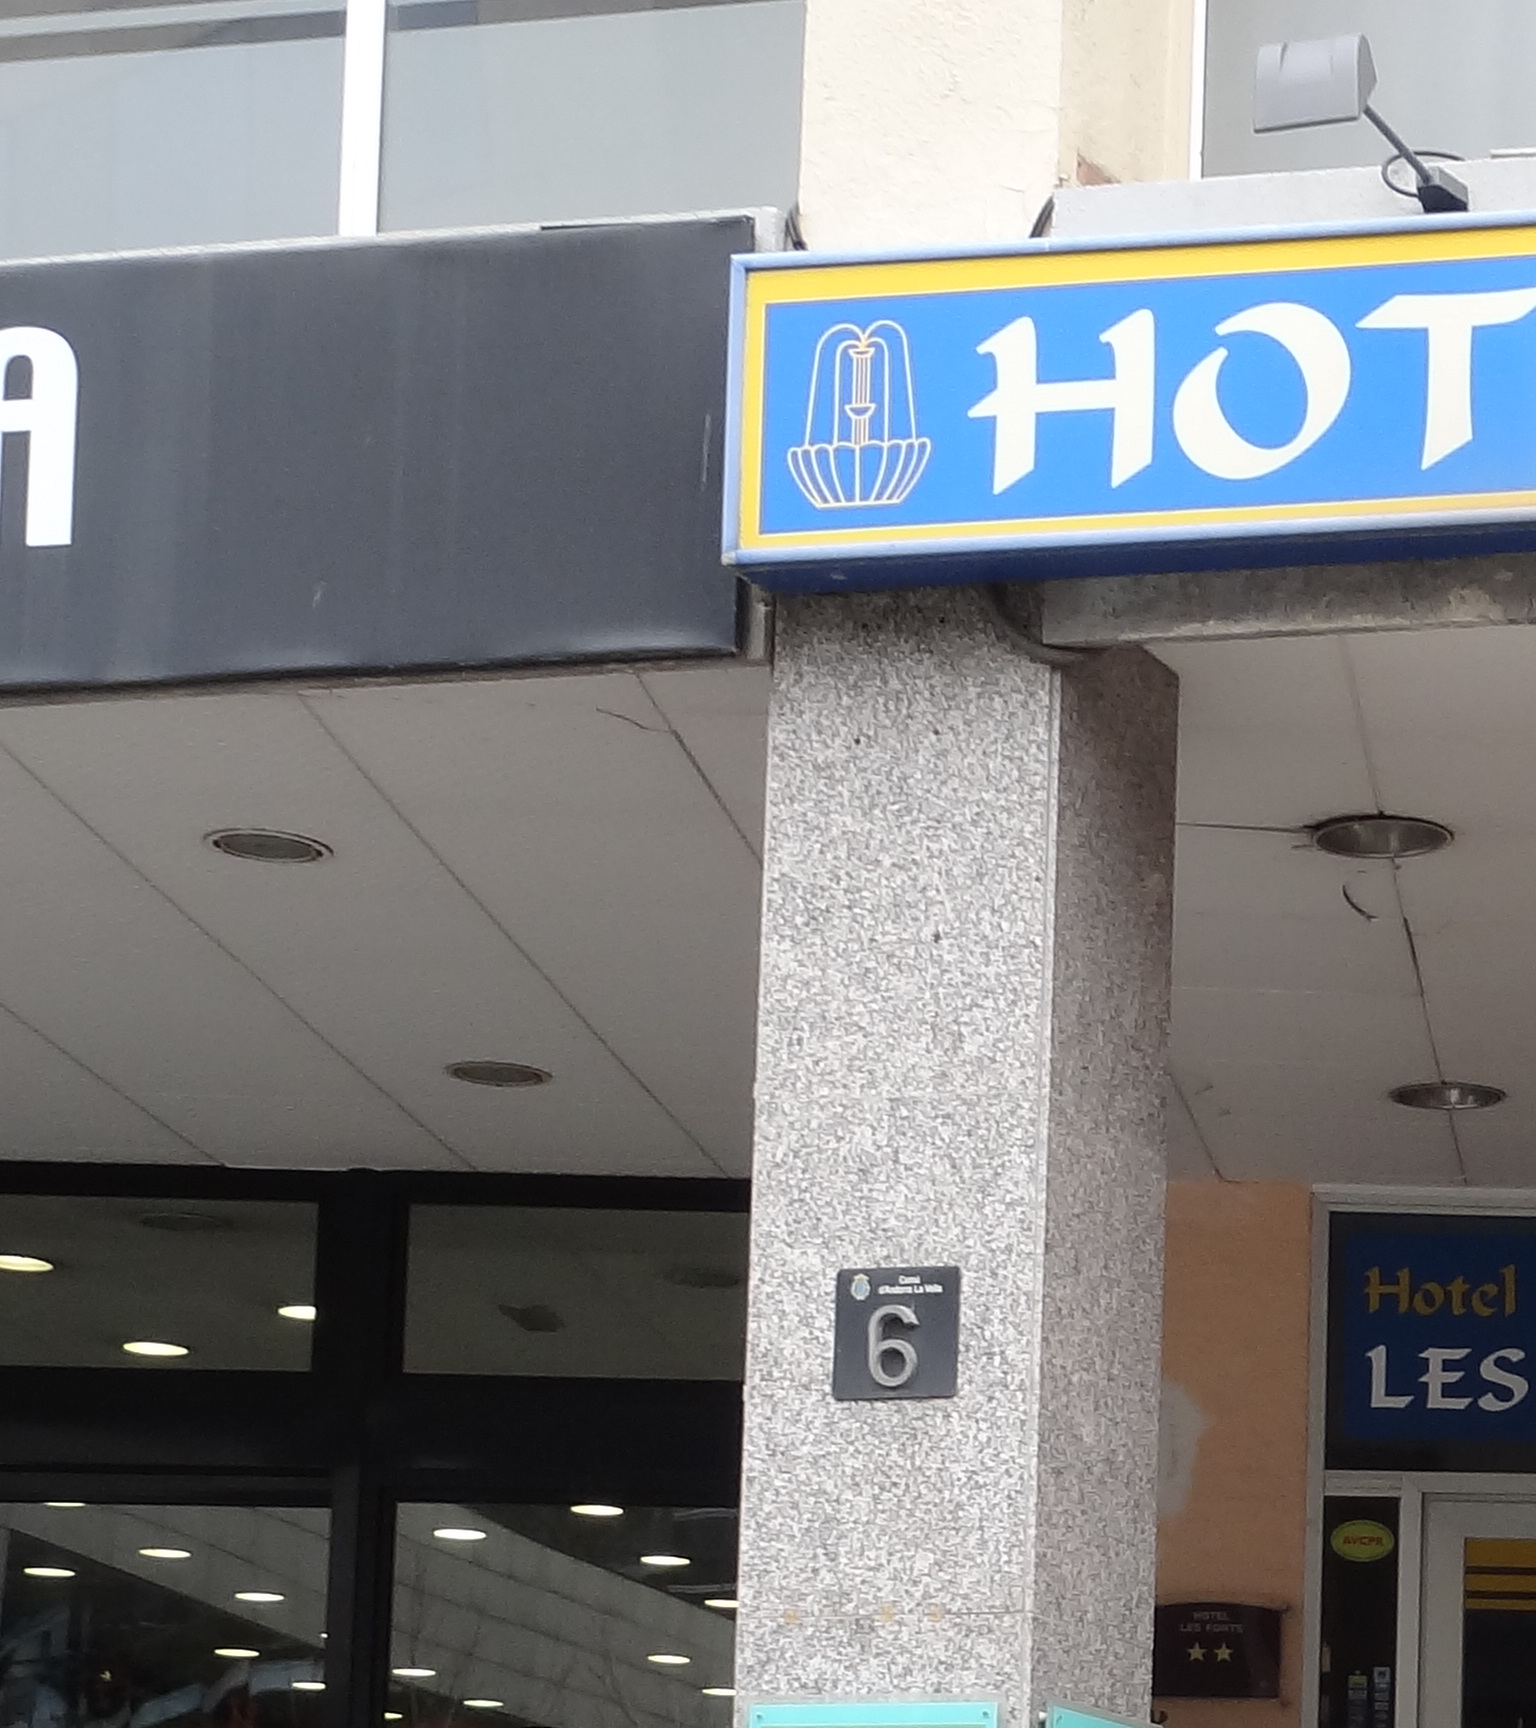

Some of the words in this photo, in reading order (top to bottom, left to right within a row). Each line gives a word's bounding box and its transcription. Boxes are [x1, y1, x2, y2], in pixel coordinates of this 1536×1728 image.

[1364, 1263, 1518, 1318] Hotel
[867, 1304, 921, 1387] 6
[1364, 1344, 1530, 1413] LES
[1193, 1611, 1230, 1620] HOTEL
